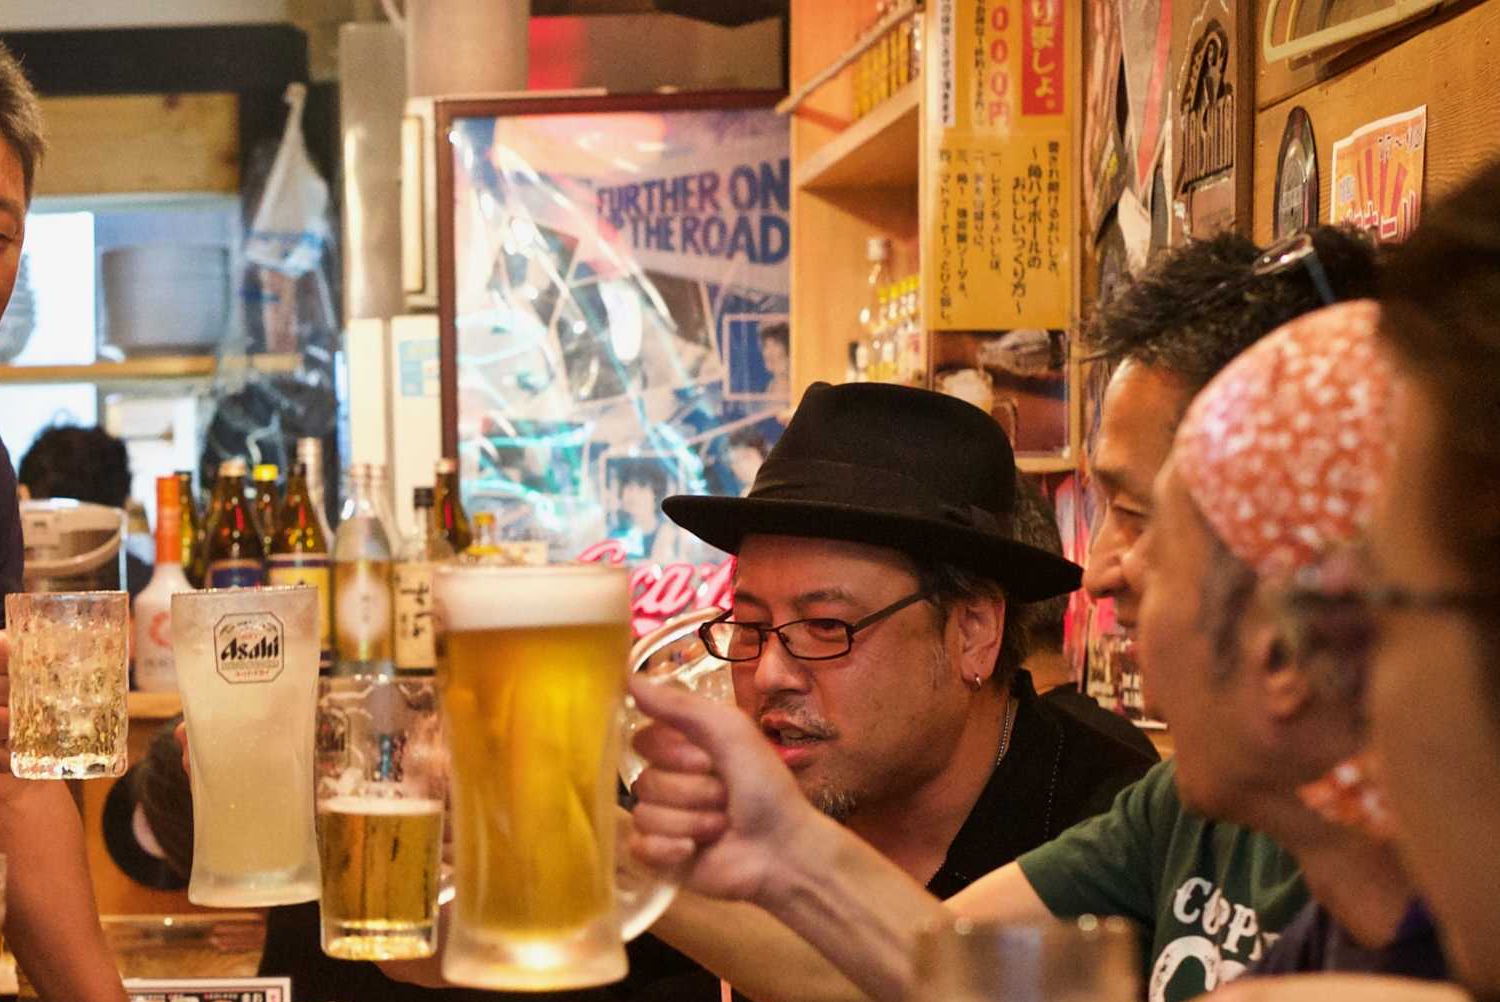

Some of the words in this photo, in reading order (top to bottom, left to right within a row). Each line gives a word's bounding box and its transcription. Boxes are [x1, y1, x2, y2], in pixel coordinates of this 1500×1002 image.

[597, 171, 720, 214] FURTHER
[729, 158, 790, 212] ON
[630, 214, 675, 251] THE
[681, 212, 790, 265] ROAD
[220, 635, 279, 660] Asahi
